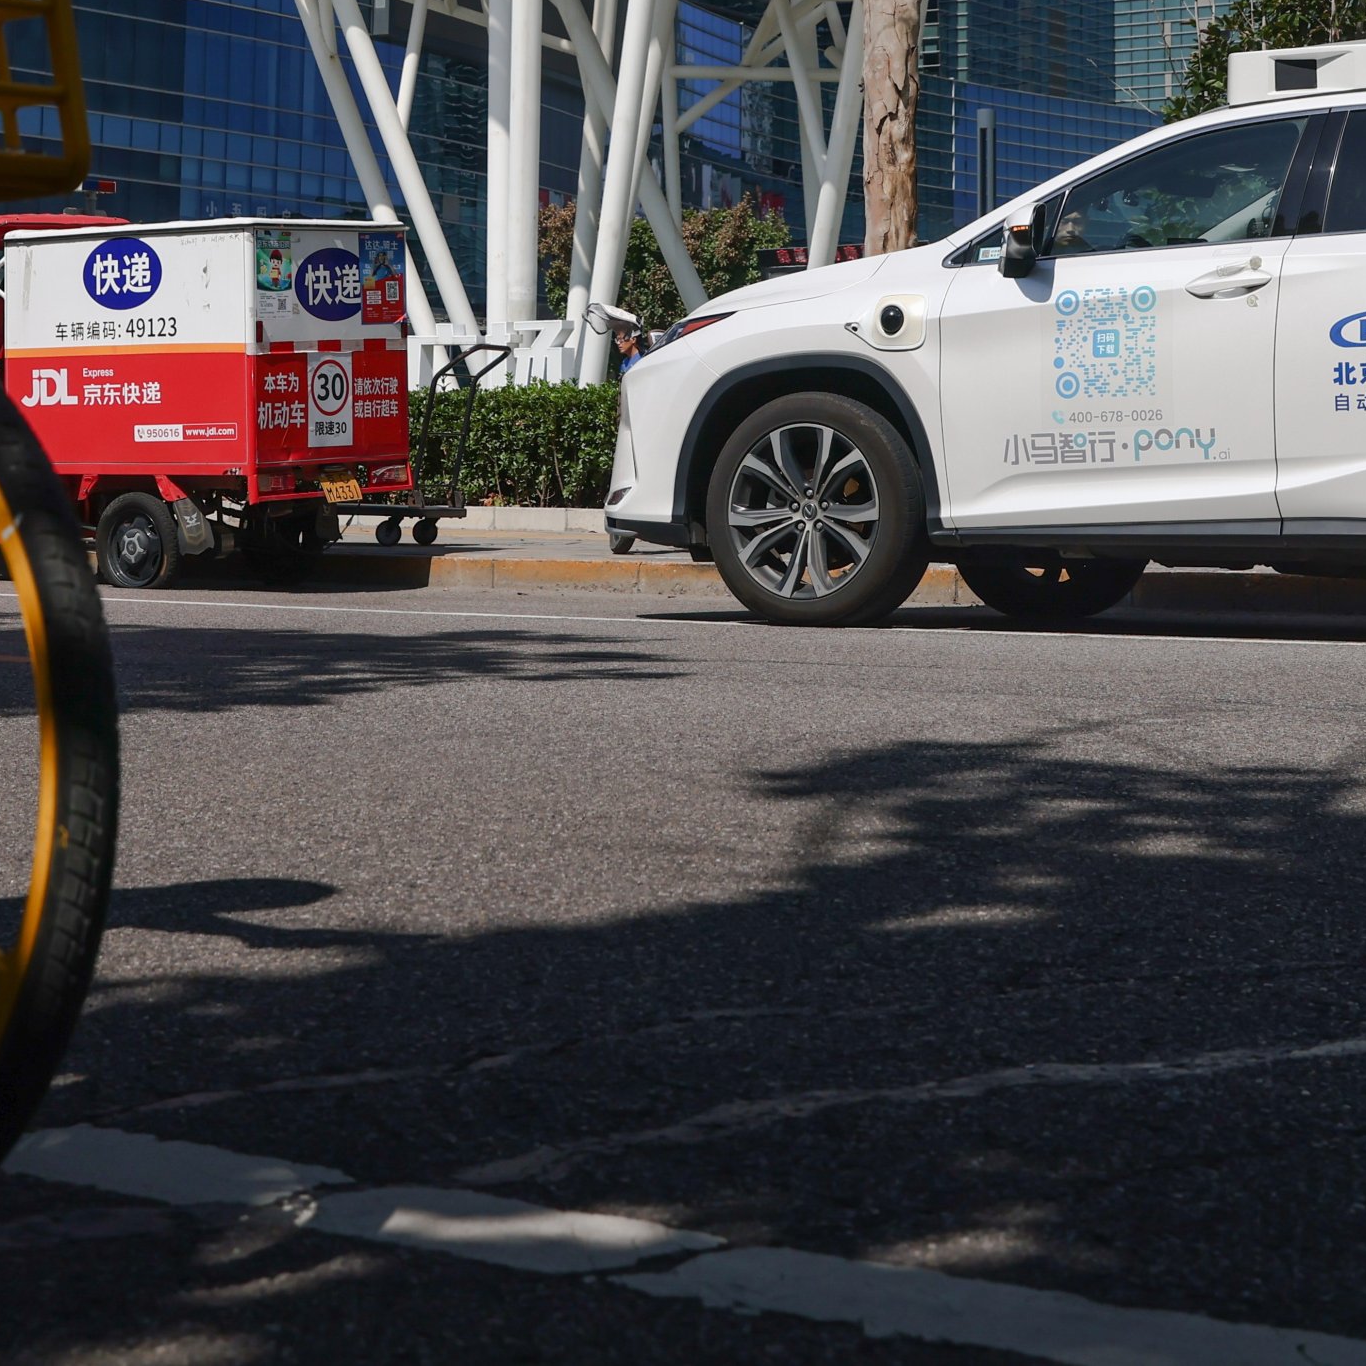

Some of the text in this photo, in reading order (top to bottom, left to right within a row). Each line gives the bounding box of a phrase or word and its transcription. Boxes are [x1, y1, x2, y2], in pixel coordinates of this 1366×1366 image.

[91, 252, 152, 296] 快递
[304, 264, 361, 306] 快递
[55, 317, 178, 341] 车辆编码: 49123
[1097, 333, 1115, 344] 扫码
[1097, 344, 1115, 355] 下载
[82, 367, 114, 379] Express
[264, 372, 300, 394] 本车为
[82, 381, 162, 406] 京东快递
[317, 373, 345, 401] 30
[354, 376, 399, 395] 请依次行驶
[258, 400, 306, 430] 机动车
[354, 399, 399, 419] 或自行超车
[1069, 409, 1163, 423] 400-678-0026
[146, 428, 180, 438] 950616
[185, 427, 235, 437] www.jdl.com
[314, 421, 347, 436] 限速30
[1003, 431, 1116, 466] 小马智行
